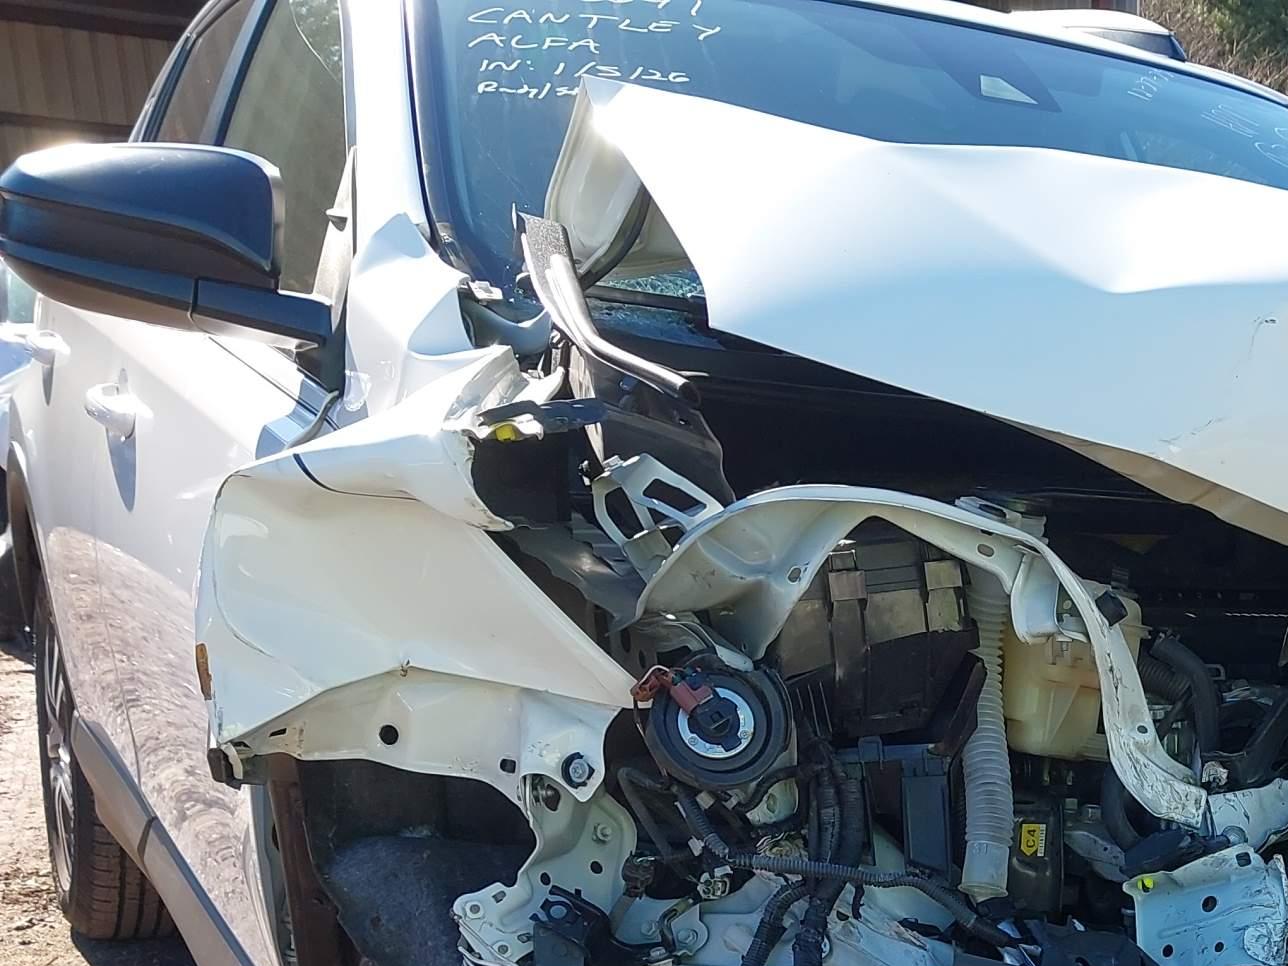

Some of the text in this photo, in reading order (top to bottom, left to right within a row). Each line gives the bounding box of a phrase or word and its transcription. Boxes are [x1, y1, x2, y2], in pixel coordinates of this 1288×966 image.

[467, 7, 722, 41] CANTLEY
[467, 32, 601, 54] ALFA
[1026, 829, 1037, 848] C4
